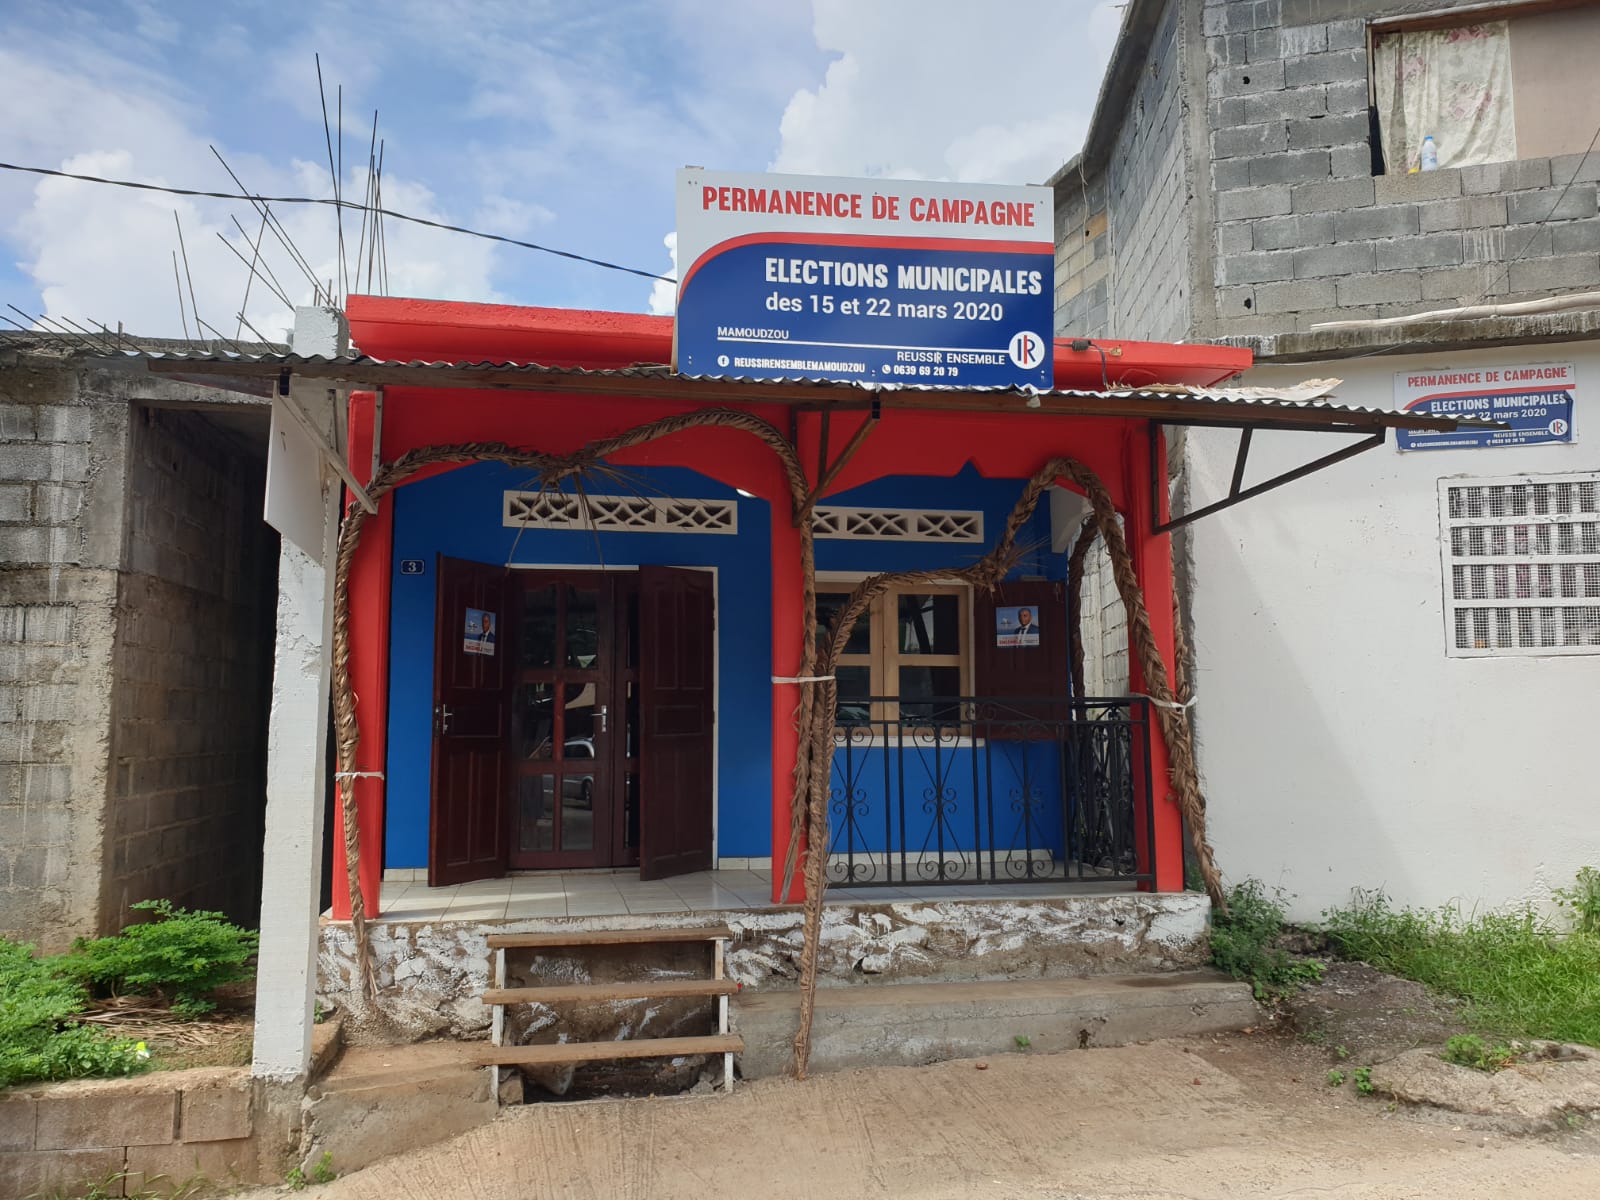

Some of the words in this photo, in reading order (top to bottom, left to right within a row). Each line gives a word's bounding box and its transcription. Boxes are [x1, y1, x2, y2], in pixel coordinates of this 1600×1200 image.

[702, 186, 862, 218] PERMANENCE
[872, 195, 900, 220] DE
[909, 197, 1035, 227] CAMPAGNE
[765, 257, 888, 288] ELECTIONS
[897, 265, 1042, 295] MUNICIPALES
[765, 292, 803, 312] des
[810, 295, 834, 314] 15
[840, 297, 860, 315] et
[866, 298, 892, 317] 22
[897, 303, 948, 319] mars
[953, 303, 1003, 321] 2020
[717, 326, 789, 339] MAMOUDZOU
[734, 357, 865, 373] REUSSIRENSEMBLEMAMOUDZOU
[897, 351, 943, 364] REUSSIR
[946, 354, 1006, 365] ENSEMBLE
[893, 365, 917, 376] 0639
[918, 366, 931, 376] 69
[933, 366, 945, 376] 20
[947, 367, 959, 377] 79
[1408, 373, 1481, 387] PERMANENCE
[1485, 371, 1499, 382] DE
[1503, 367, 1568, 382] CAMPAGNE
[1430, 398, 1490, 413] ELECTIONS
[1493, 393, 1567, 408] MUNICIPALES
[1493, 411, 1519, 419] mars
[1521, 408, 1547, 417] 2020
[408, 562, 416, 572] 3
